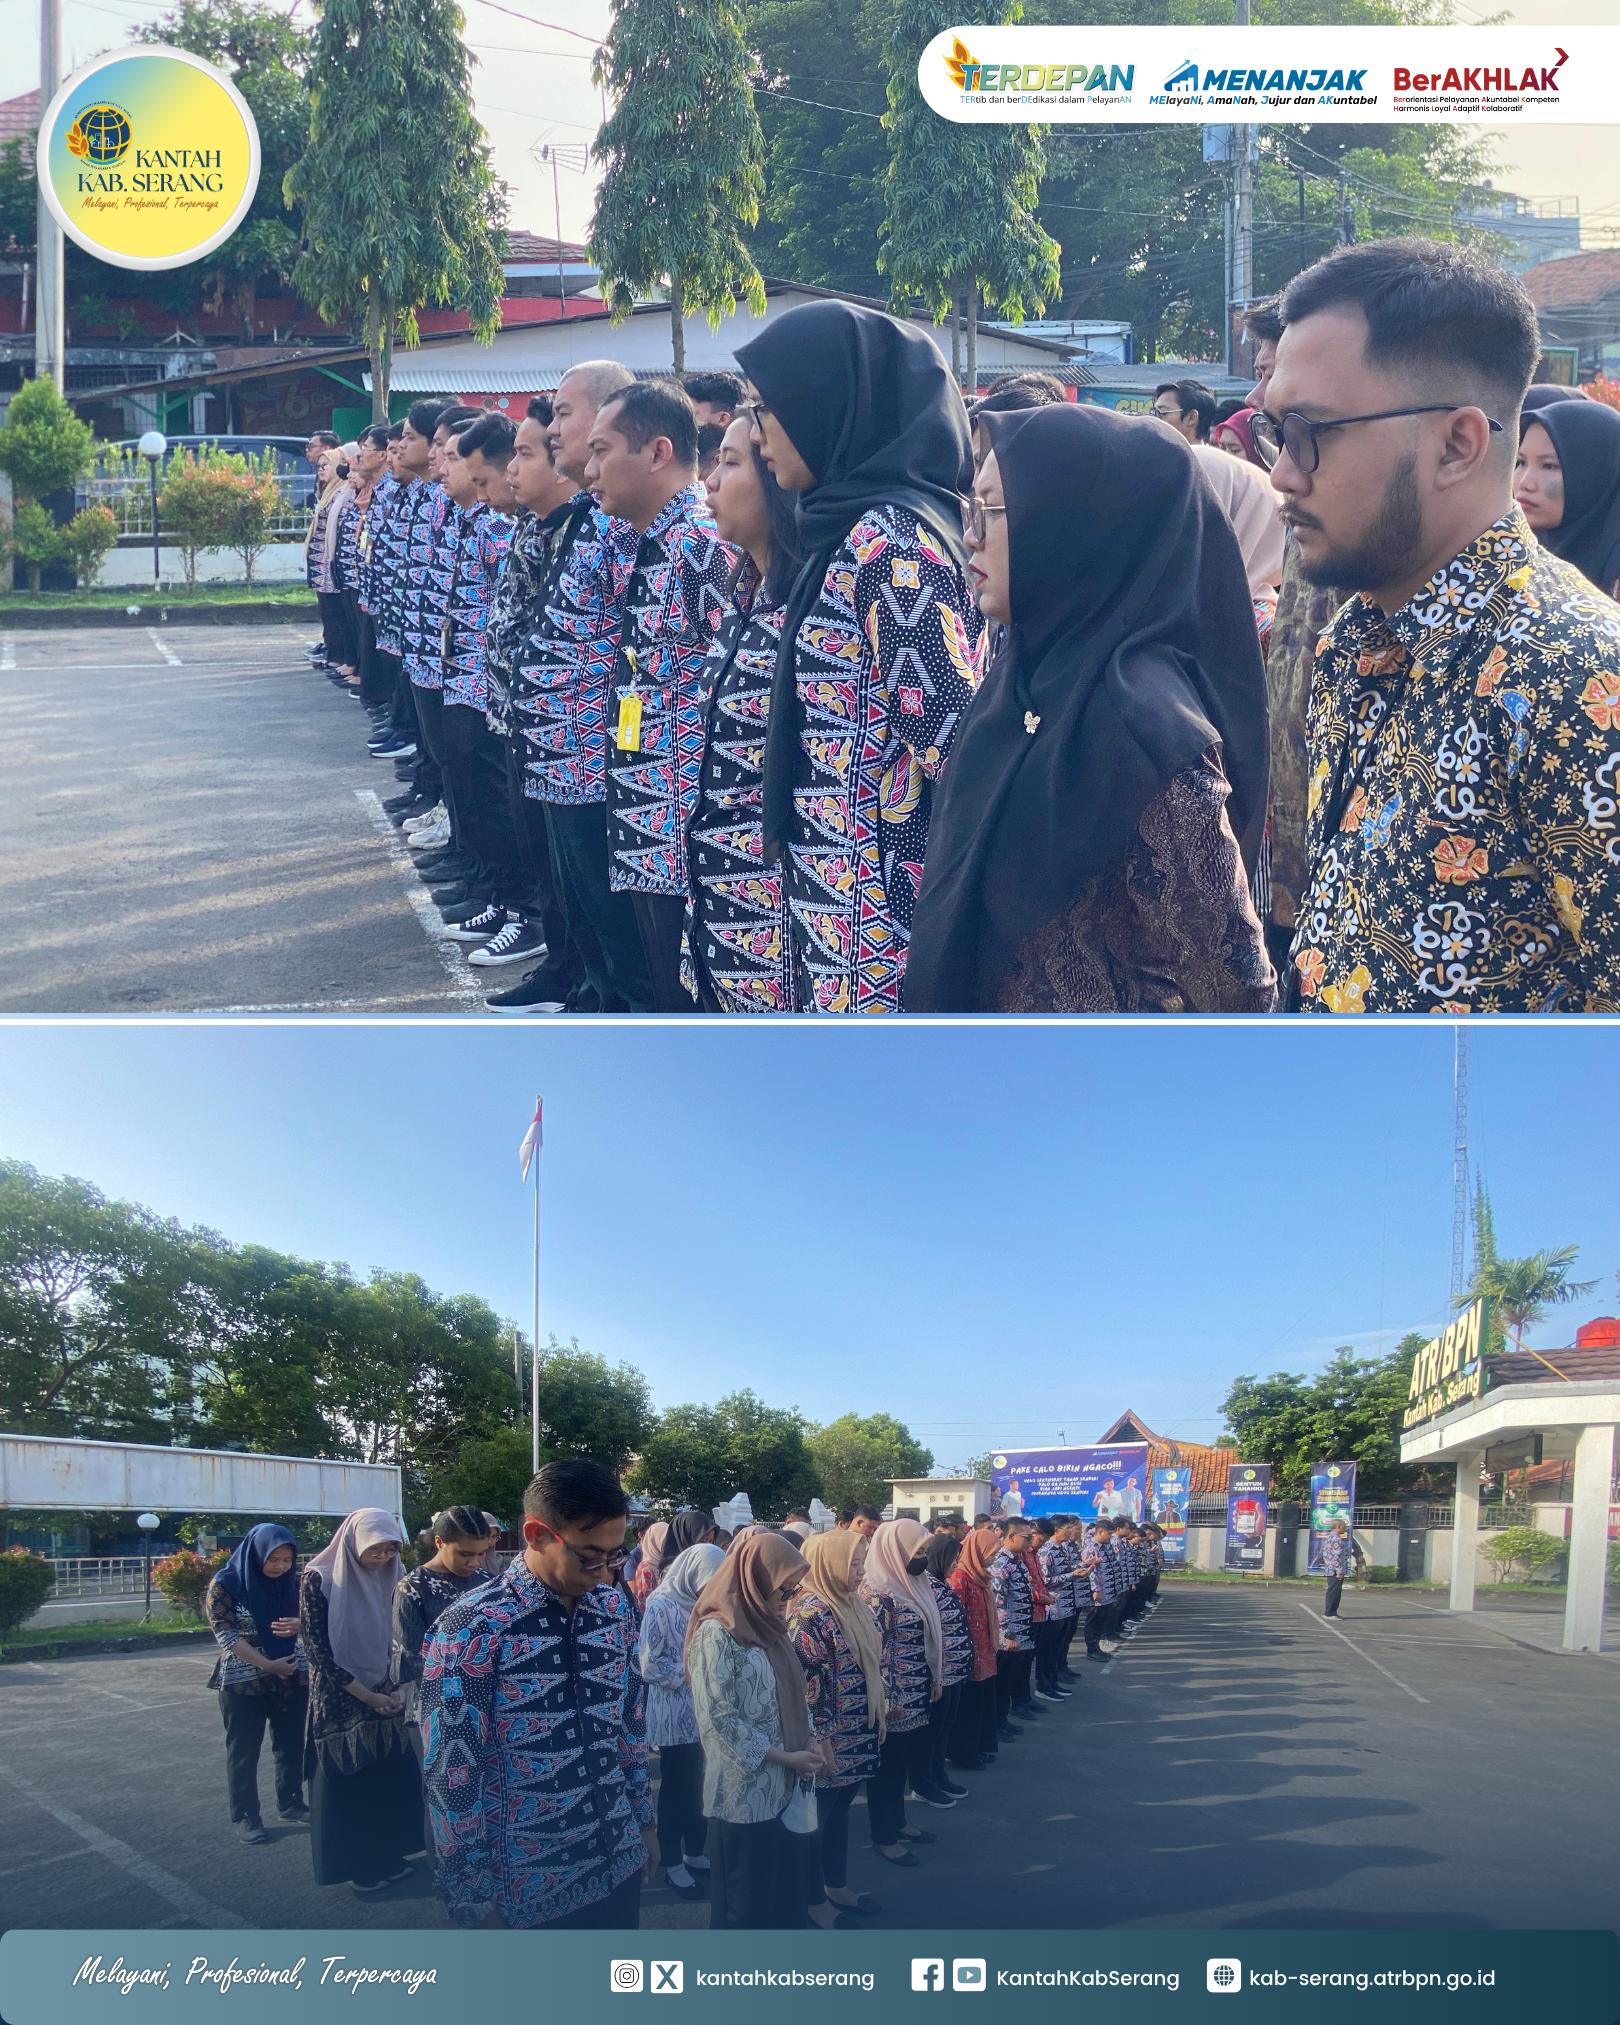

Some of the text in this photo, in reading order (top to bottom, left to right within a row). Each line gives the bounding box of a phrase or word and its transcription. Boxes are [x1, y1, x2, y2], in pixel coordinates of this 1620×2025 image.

[1409, 1298, 1482, 1401] ATR/BPN
[1446, 1371, 1481, 1403] Serang
[1010, 1460, 1121, 1475] PAKE CALO BIKIN NGACO!!!
